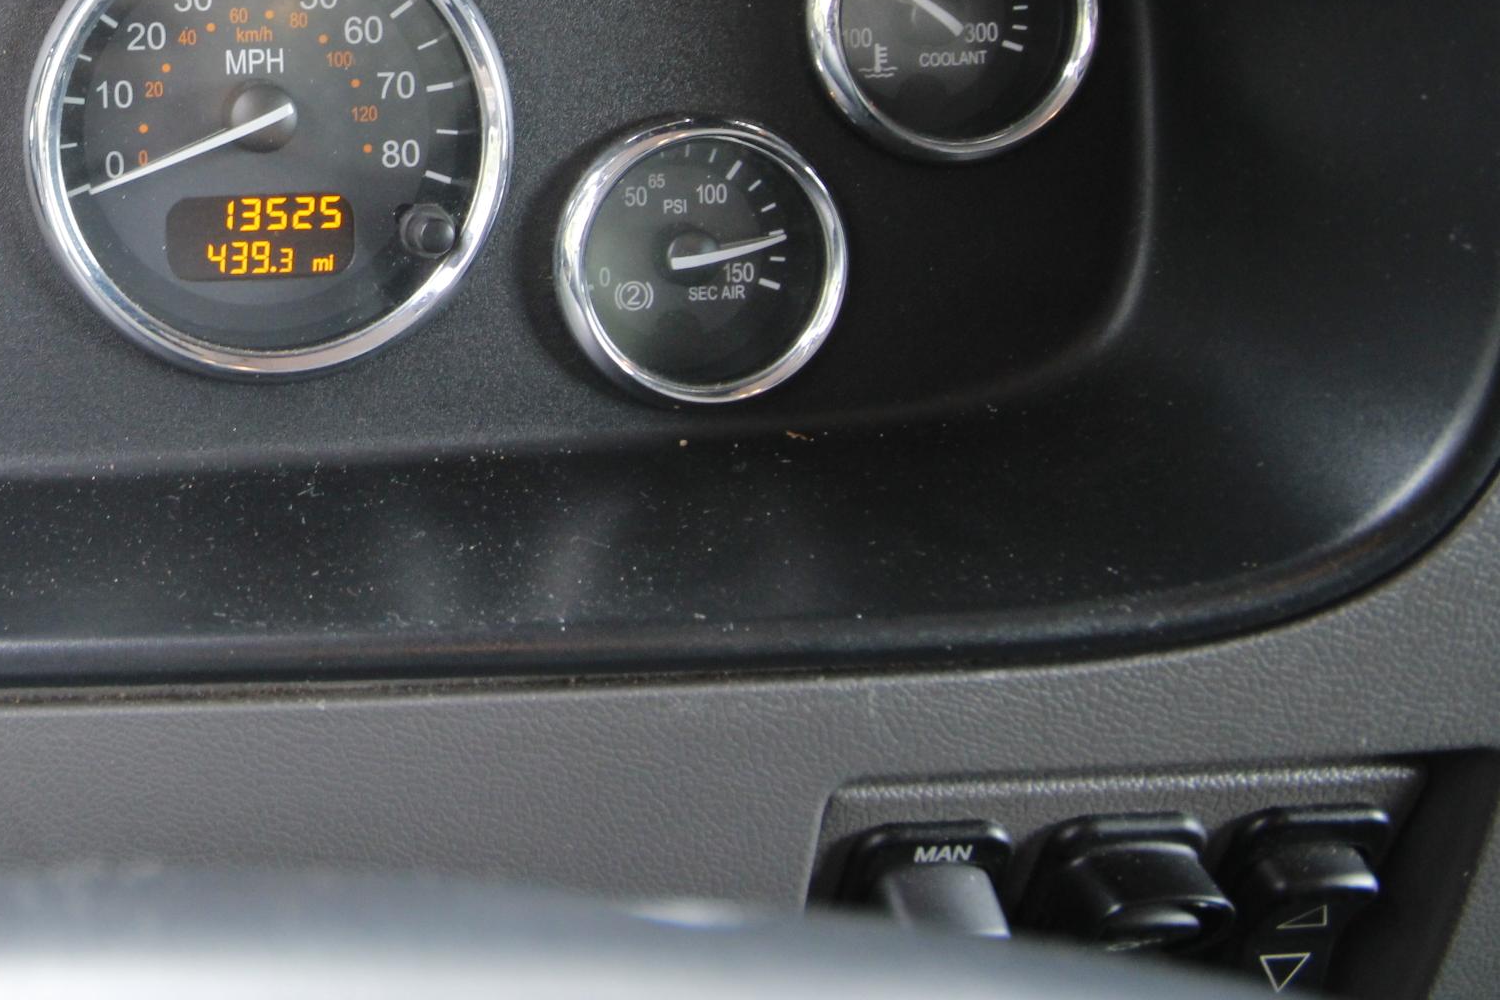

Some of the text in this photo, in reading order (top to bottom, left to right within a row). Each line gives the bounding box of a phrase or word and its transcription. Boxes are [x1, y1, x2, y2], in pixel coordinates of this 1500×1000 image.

[230, 8, 248, 24] 60
[290, 12, 308, 28] 80
[126, 22, 167, 51] 20
[178, 30, 197, 46] 40
[236, 26, 274, 44] km/h
[344, 16, 383, 45] 60
[964, 23, 998, 43] 300
[224, 48, 285, 75] MPH
[326, 52, 353, 68] 100
[919, 50, 987, 67] COOLANT
[95, 80, 134, 110] 10
[145, 81, 163, 98] 20
[376, 71, 416, 100] 70
[352, 107, 378, 123] 120
[381, 140, 420, 169] 80
[105, 151, 125, 180] 0
[648, 174, 665, 189] 65
[625, 187, 648, 207] 50
[696, 184, 728, 205] 100
[224, 195, 342, 232] 13525
[663, 199, 688, 214] PSI
[207, 240, 335, 275] 439.3 mi
[600, 267, 611, 288] 0
[723, 263, 755, 283] 150
[688, 285, 746, 301] SEC AIR
[914, 844, 974, 864] MAN
